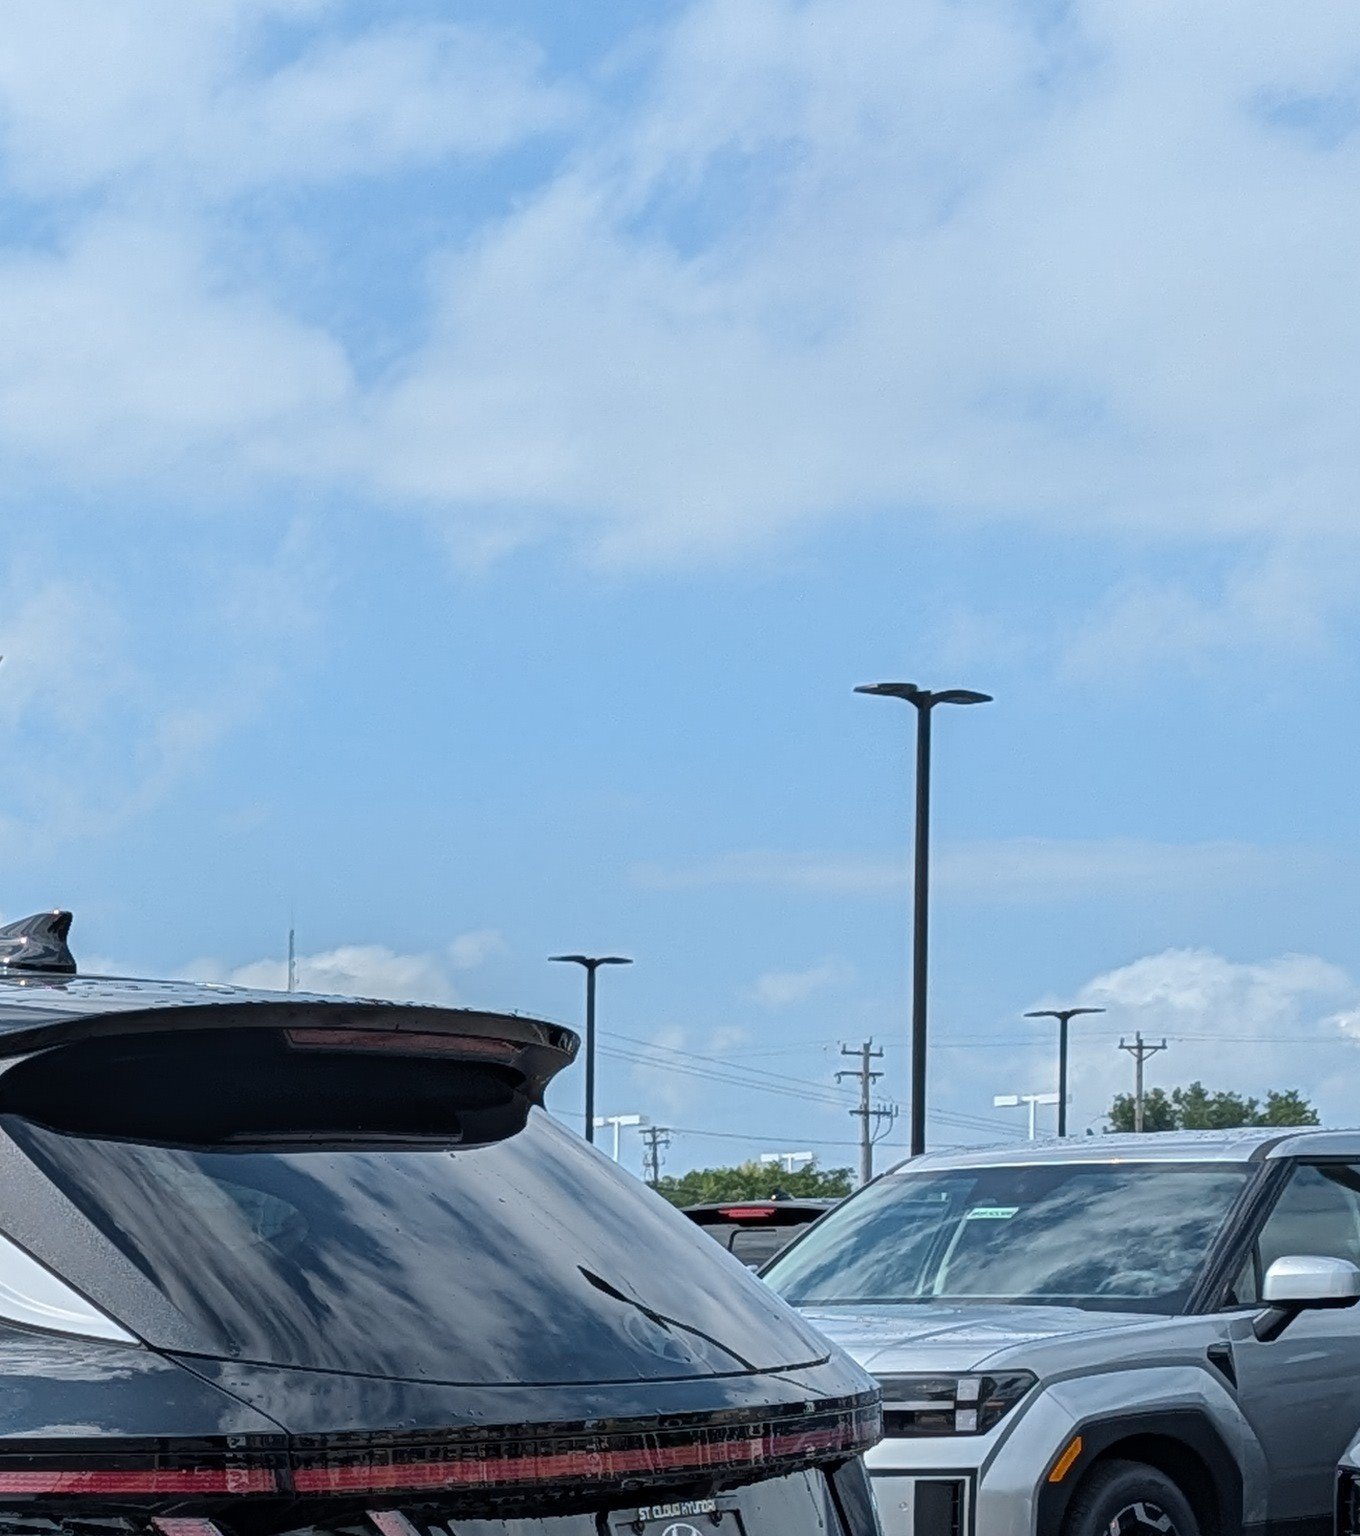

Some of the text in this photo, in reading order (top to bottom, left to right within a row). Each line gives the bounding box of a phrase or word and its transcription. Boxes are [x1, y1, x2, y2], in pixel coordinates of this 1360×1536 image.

[638, 1499, 716, 1521] ST CLOUD HYUNDAI
